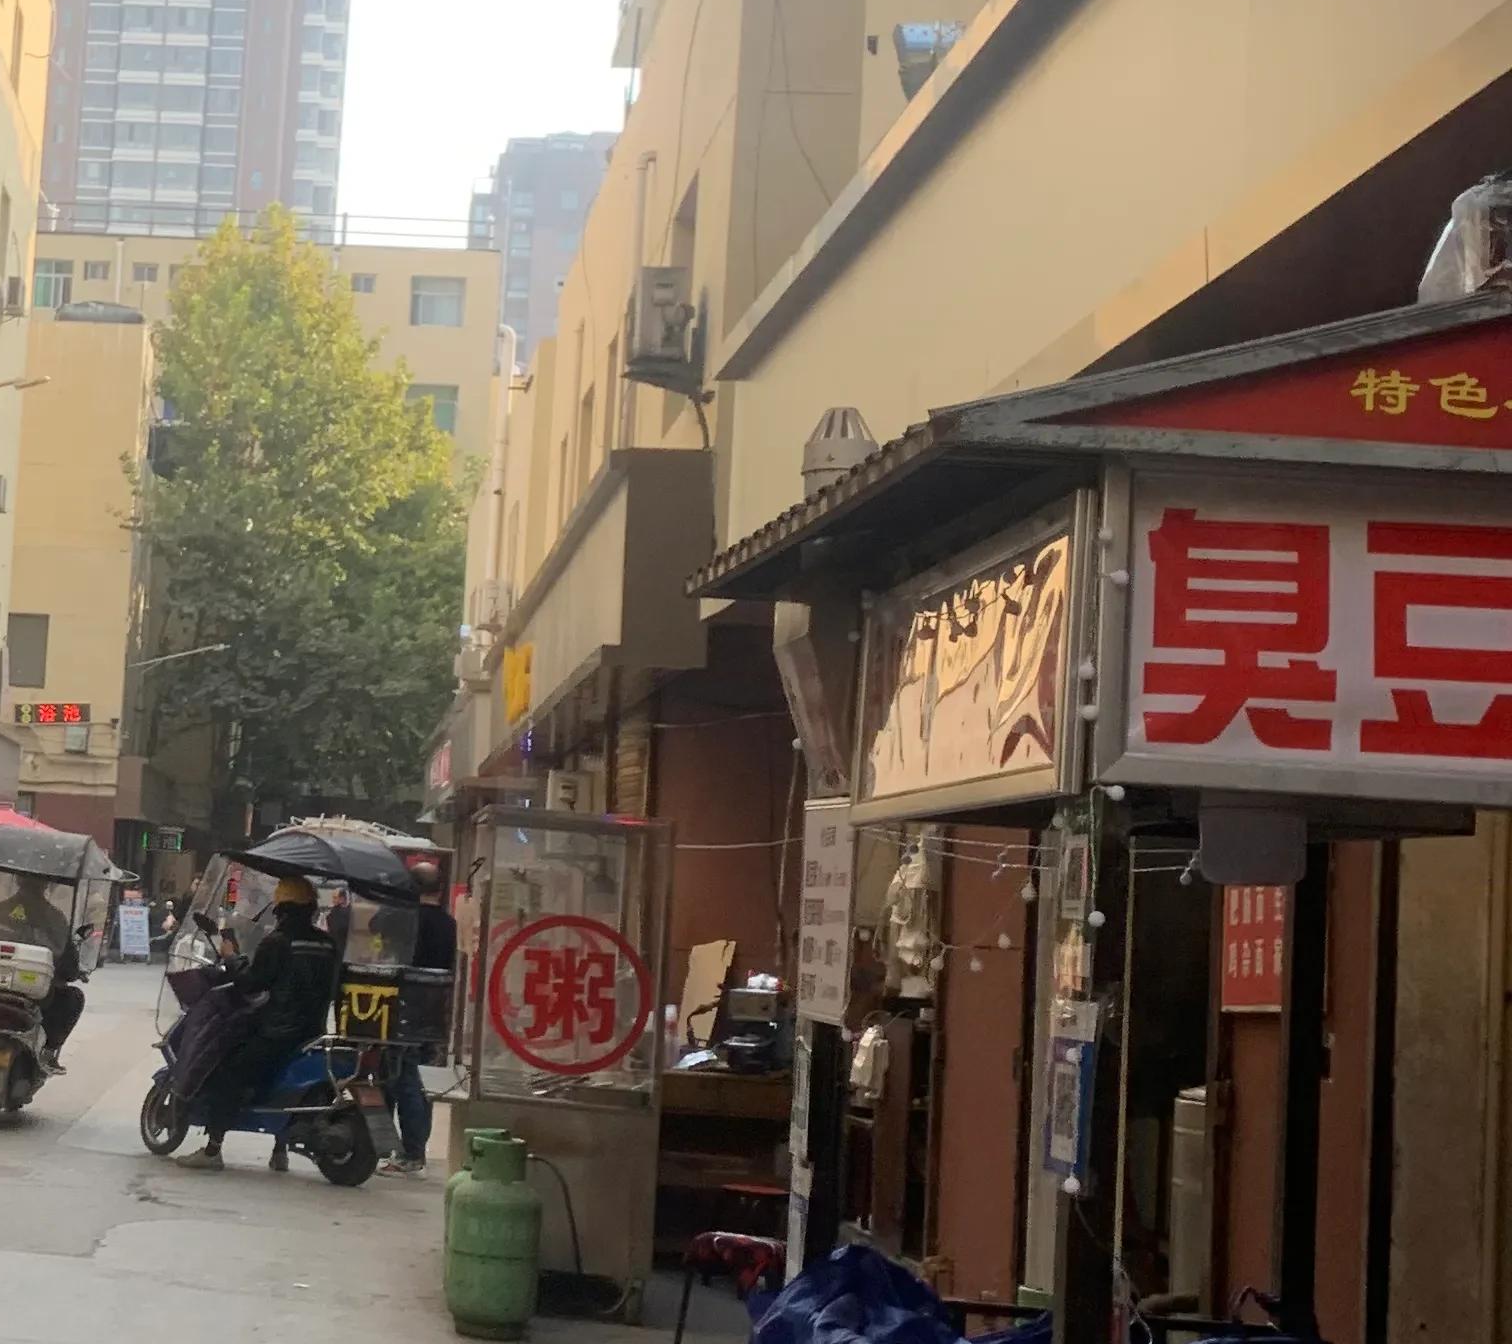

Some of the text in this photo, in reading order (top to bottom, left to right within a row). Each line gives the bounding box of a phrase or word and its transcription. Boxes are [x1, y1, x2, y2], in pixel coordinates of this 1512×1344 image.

[1350, 368, 1512, 419] 特色
[1142, 507, 1512, 756] 臭豆
[39, 704, 82, 723] 浴池
[522, 948, 617, 1044] 粥
